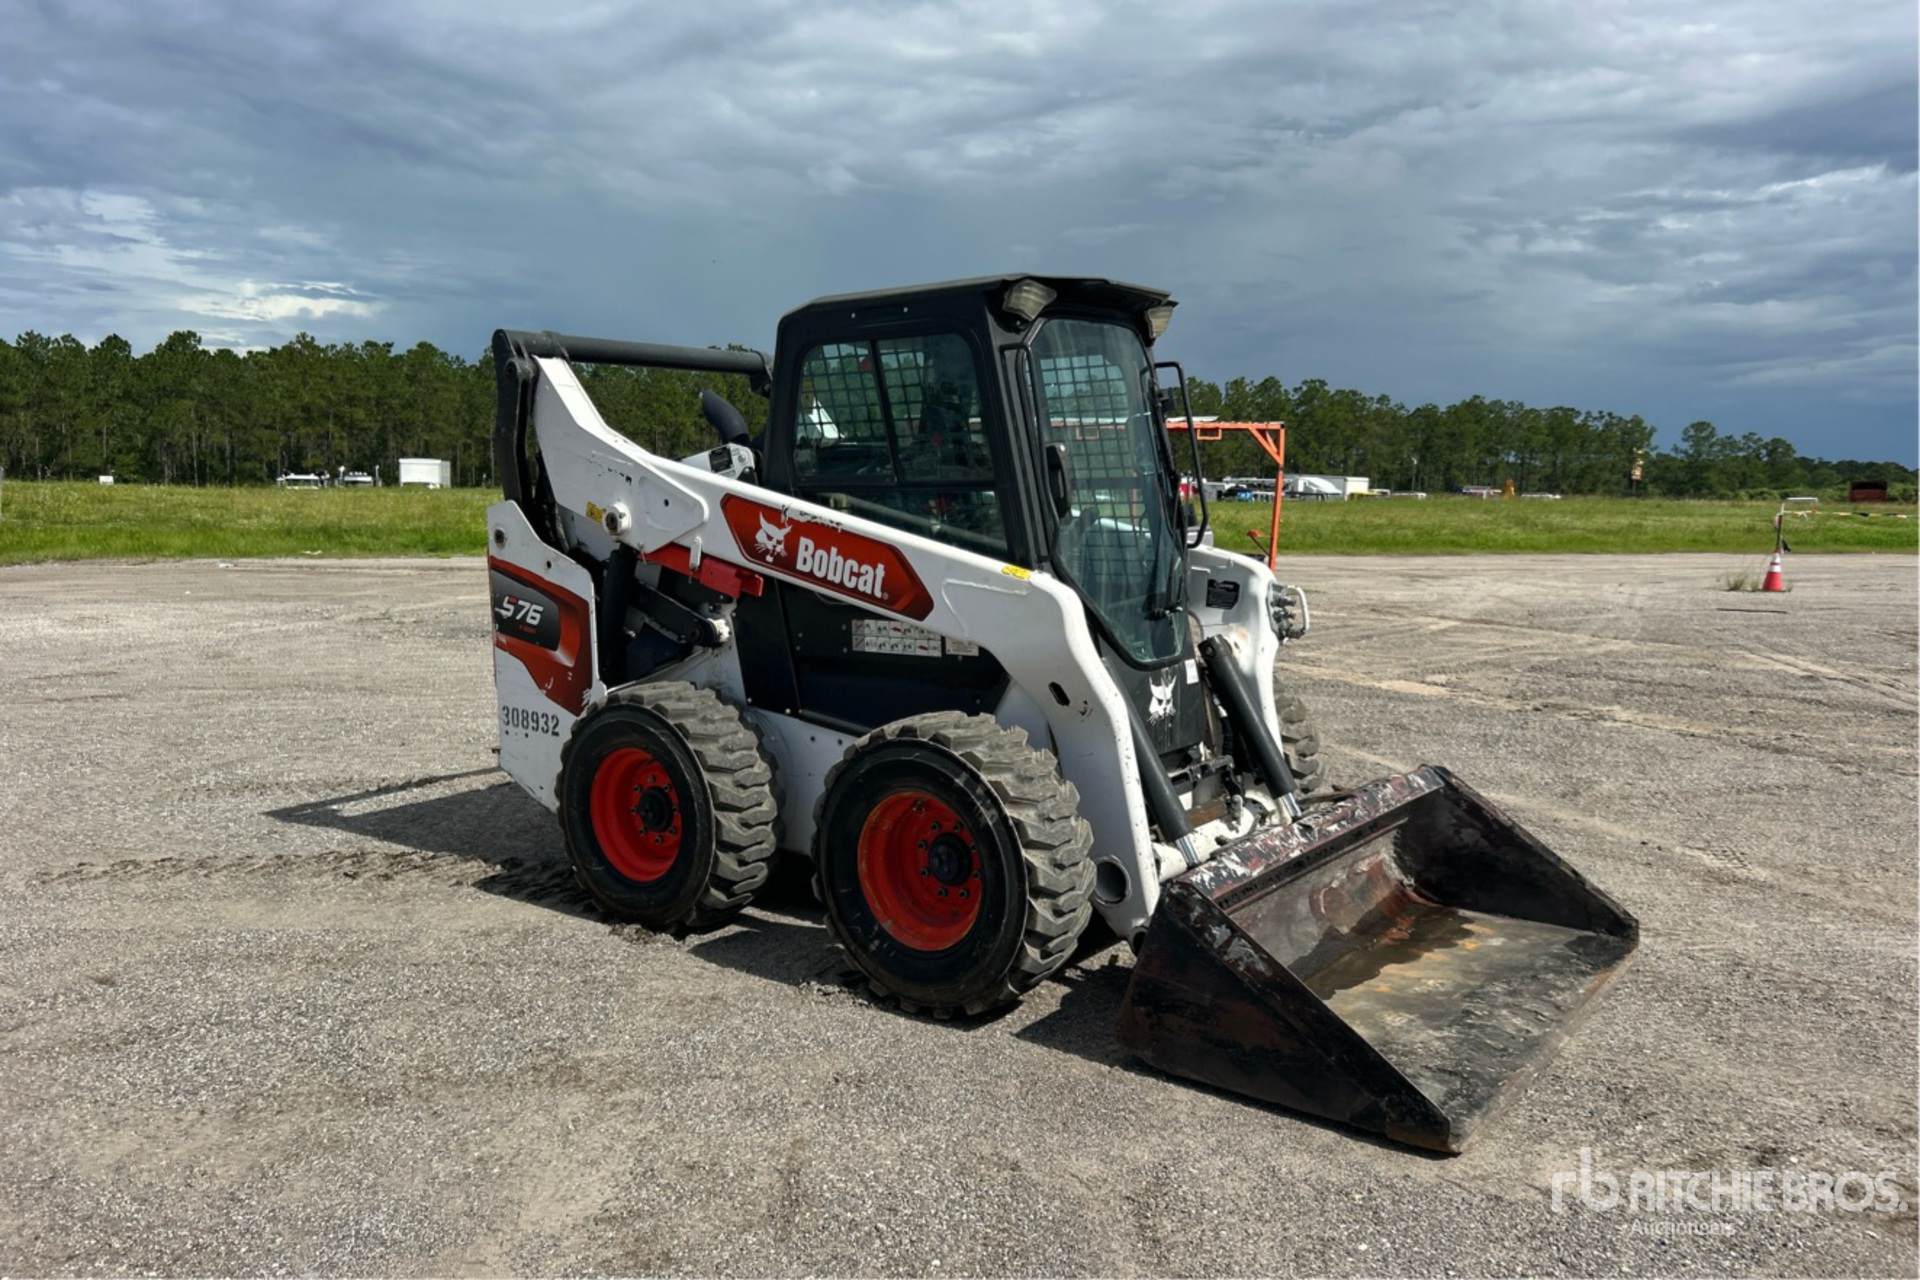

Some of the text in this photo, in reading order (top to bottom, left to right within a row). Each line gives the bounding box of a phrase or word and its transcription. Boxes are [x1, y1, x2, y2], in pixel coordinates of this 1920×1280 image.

[796, 537, 886, 599] Bobcat
[503, 595, 544, 625] S76
[502, 705, 560, 736] 308932
